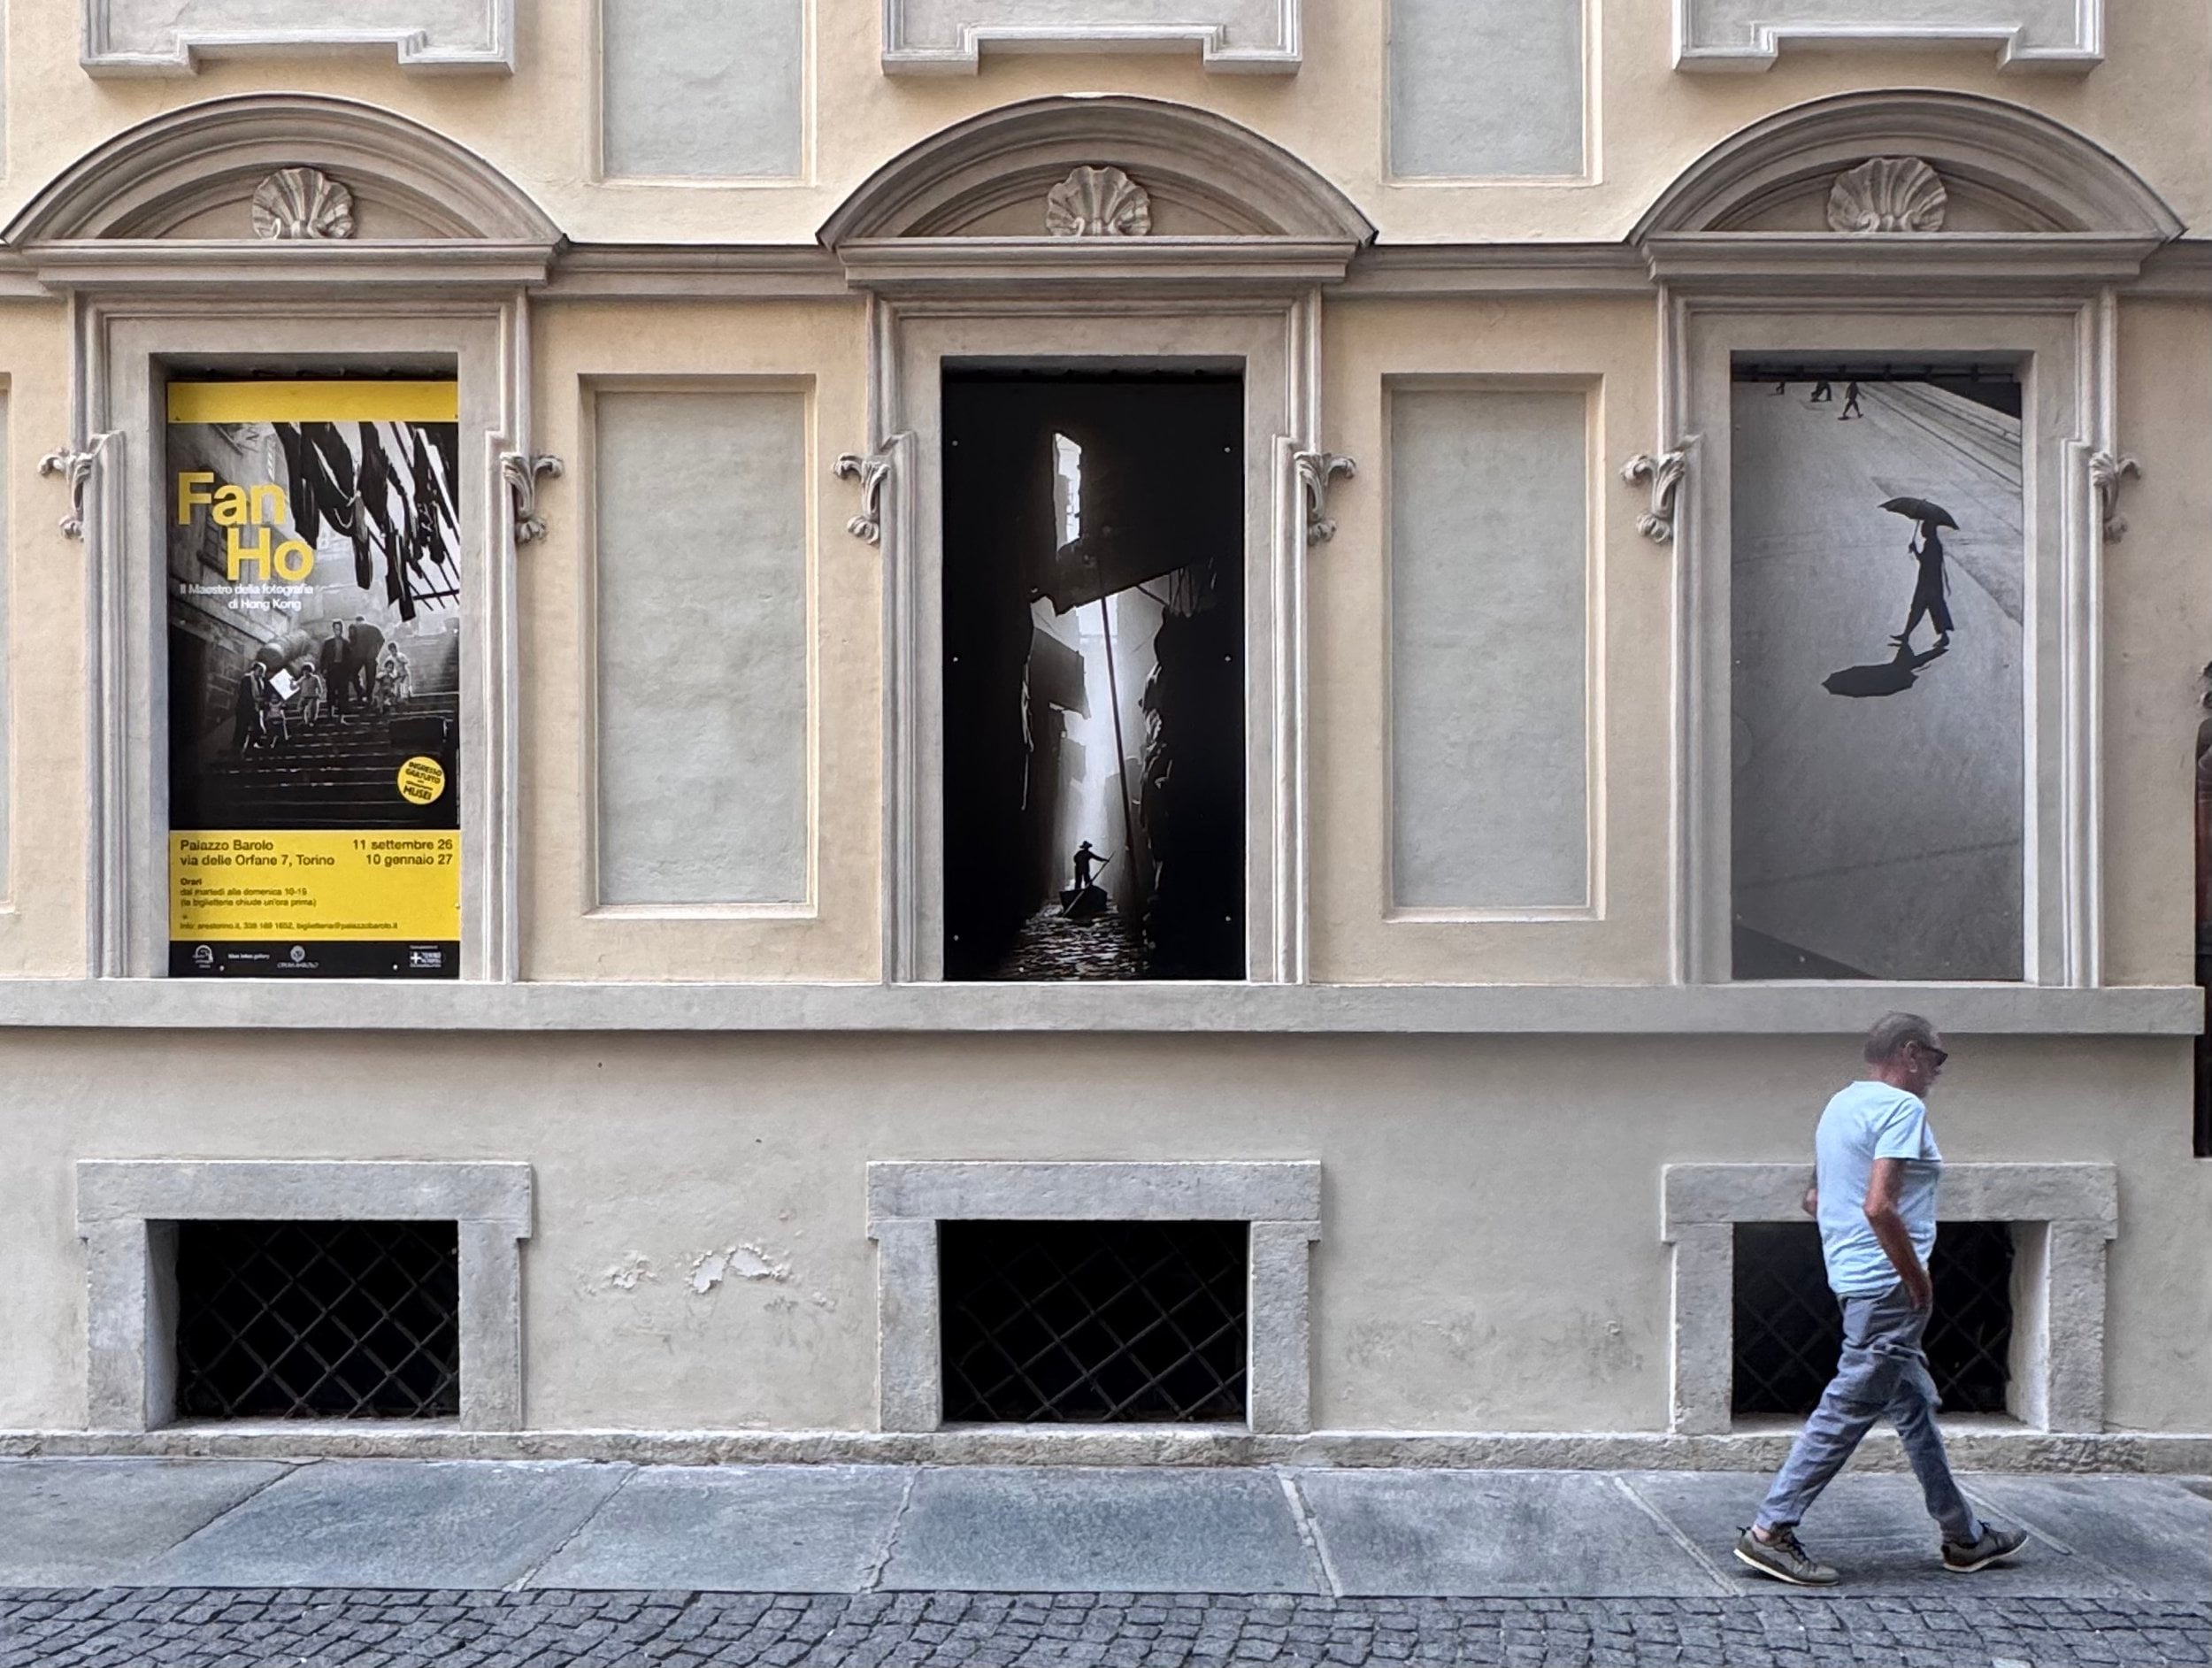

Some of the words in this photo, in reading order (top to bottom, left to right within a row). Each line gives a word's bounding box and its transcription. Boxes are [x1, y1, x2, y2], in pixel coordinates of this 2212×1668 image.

[178, 472, 285, 526] Fan
[227, 527, 314, 580] Ho
[180, 584, 186, 595] Il
[188, 584, 232, 595] Maestro
[234, 583, 260, 595] della
[261, 583, 313, 597] fotografia
[228, 599, 238, 610] di
[241, 599, 270, 612] Hong
[273, 599, 302, 612] Kong
[405, 768, 441, 784] GRATUITO
[403, 786, 432, 800] MUSEI
[180, 840, 229, 850] Palazzo
[234, 840, 273, 850] Barolo
[353, 840, 365, 849] 11
[371, 840, 434, 849] settembre
[438, 839, 452, 849] 26
[180, 855, 198, 865] via
[202, 855, 231, 865] delle
[235, 855, 277, 865] Orfane
[281, 855, 292, 866] 7,
[296, 855, 334, 865] Torino
[366, 855, 380, 865] 10
[385, 854, 434, 867] gennaio
[438, 854, 452, 865] 27
